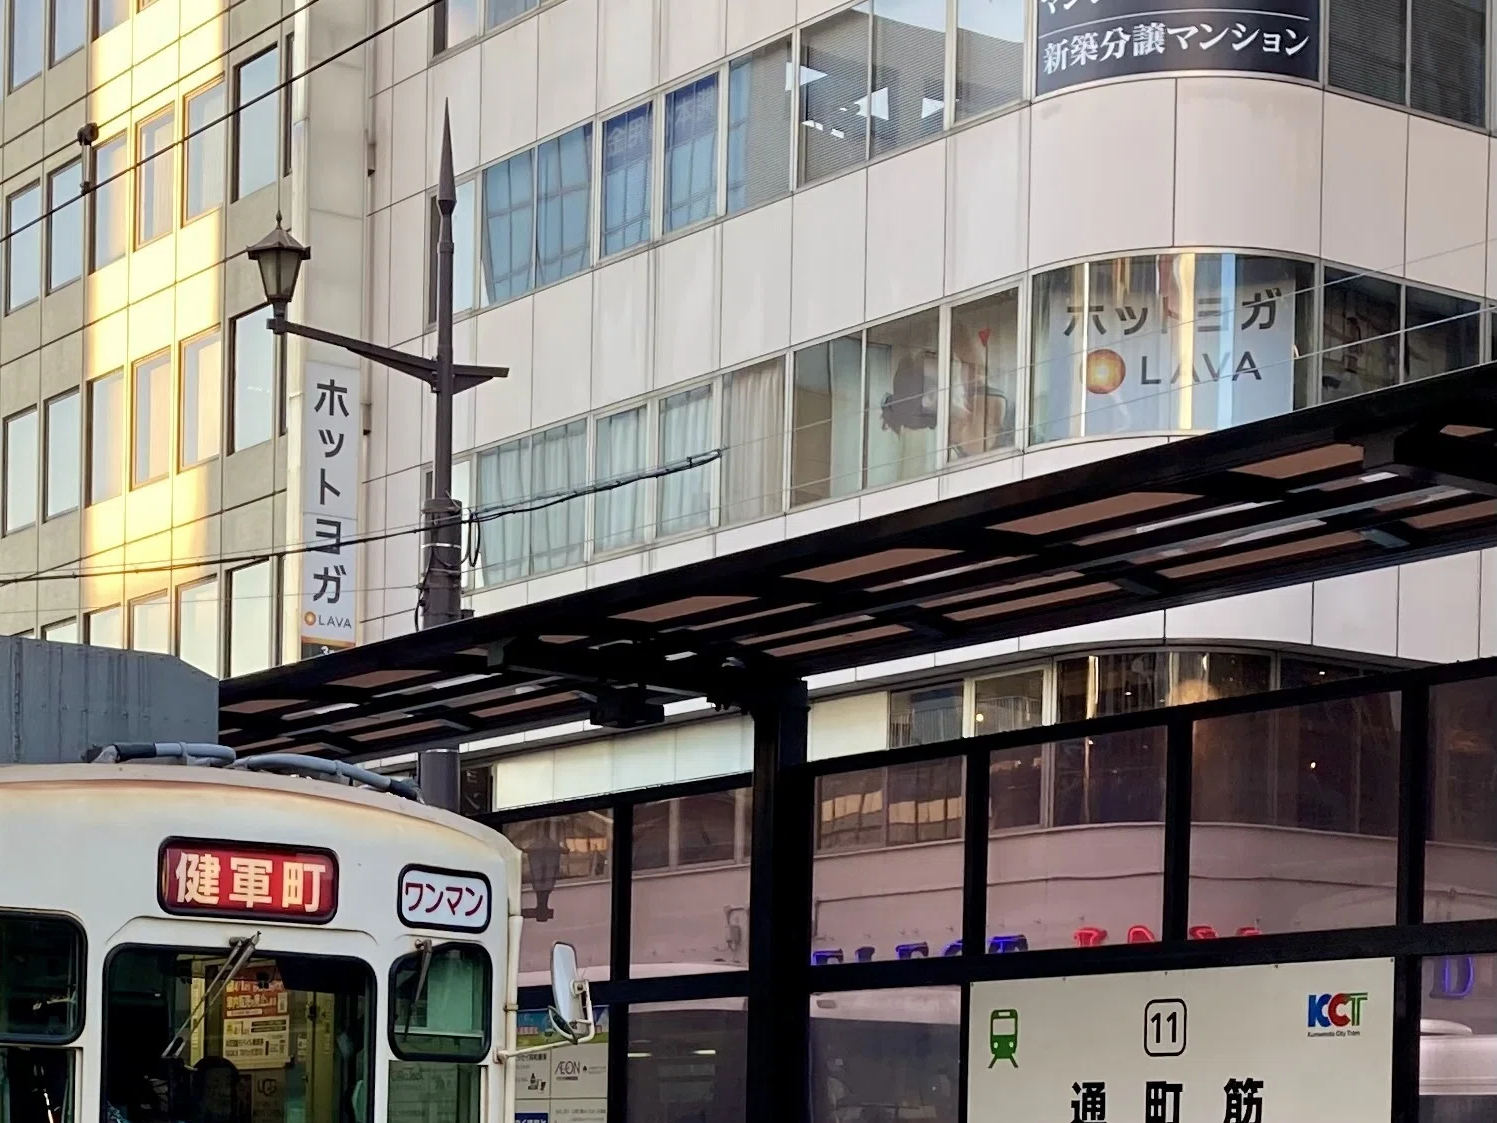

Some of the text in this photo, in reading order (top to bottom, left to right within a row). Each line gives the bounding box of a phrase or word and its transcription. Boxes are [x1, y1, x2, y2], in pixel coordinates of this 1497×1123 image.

[1043, 22, 1310, 75] 新築分譲マンション
[1063, 287, 1282, 337] ホットヨガ
[1140, 351, 1263, 386] LAVA
[312, 378, 350, 605] ホットヨガ
[318, 616, 353, 630] LAVA
[175, 851, 326, 913] 健軍町
[405, 882, 483, 917] ワンマン
[1150, 1011, 1178, 1044] 11
[1307, 992, 1368, 1028] KCT
[1336, 1030, 1346, 1038] City
